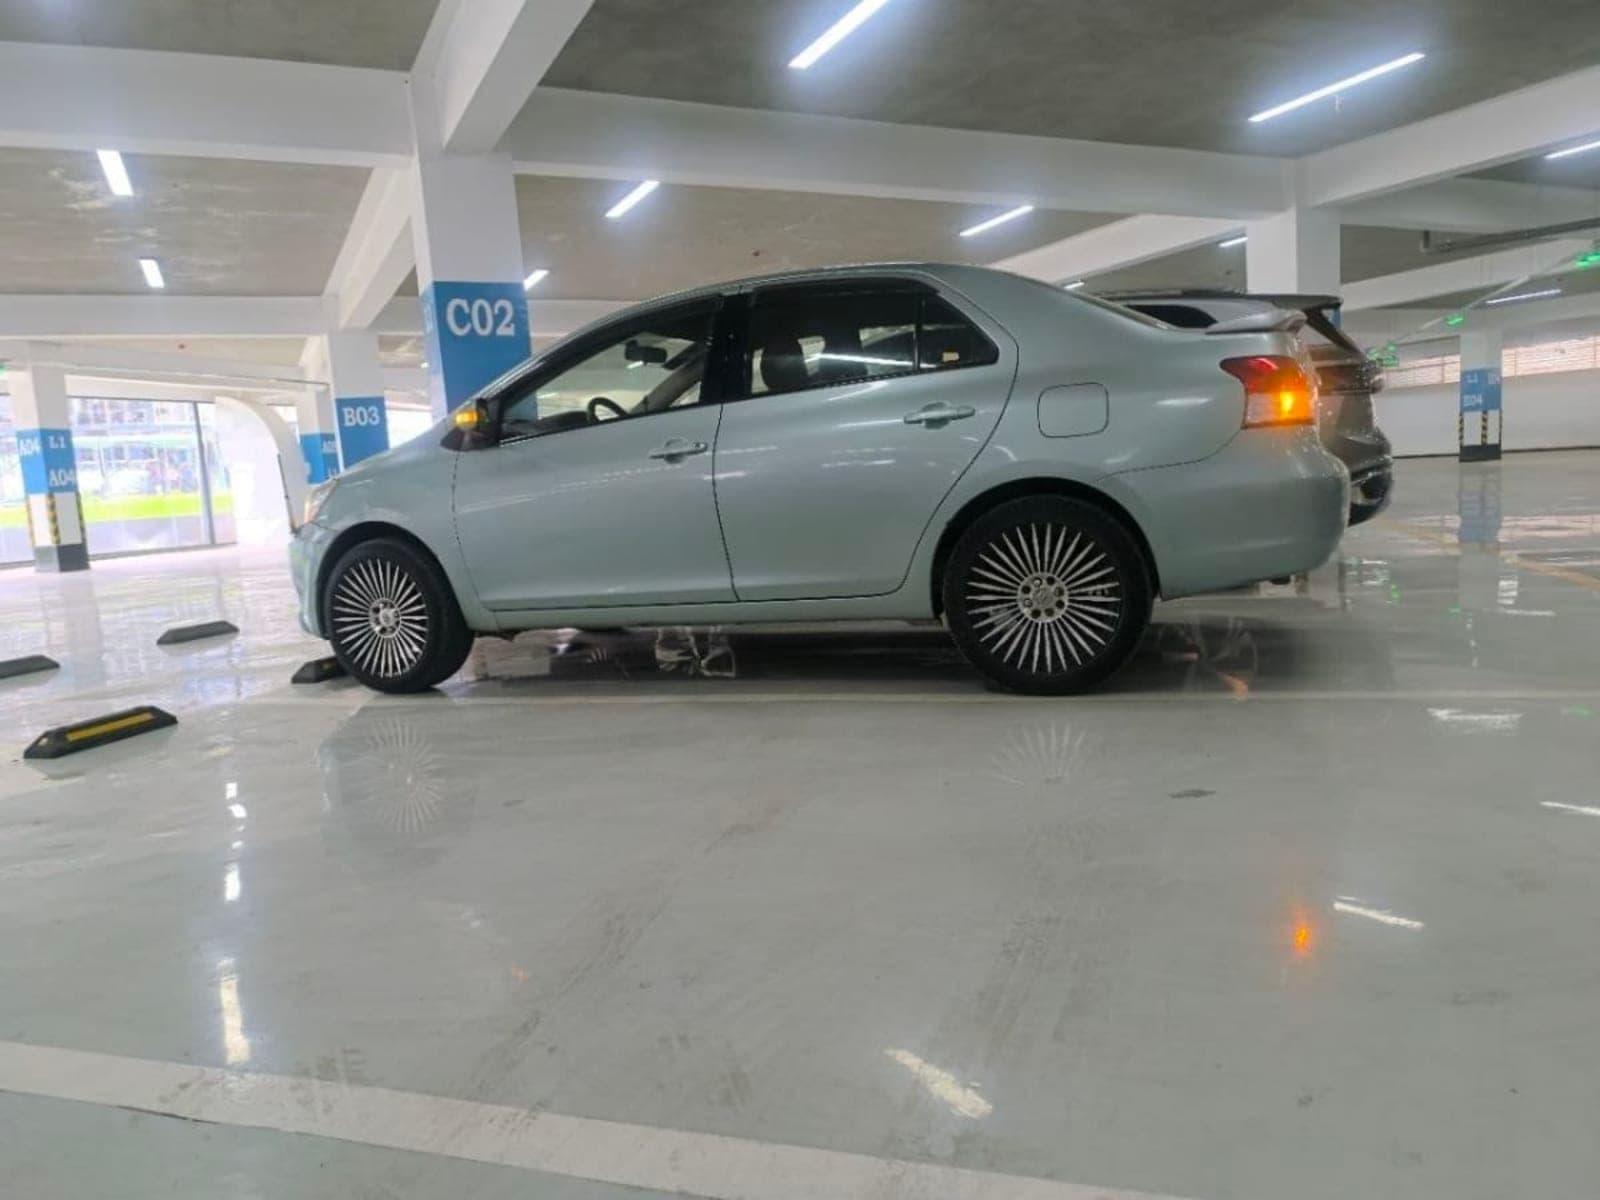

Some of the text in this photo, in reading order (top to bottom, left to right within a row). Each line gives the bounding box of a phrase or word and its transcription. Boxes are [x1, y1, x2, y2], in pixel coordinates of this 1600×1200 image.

[446, 298, 515, 336] C02
[344, 406, 380, 426] B03
[49, 436, 66, 448] L1
[49, 470, 76, 486] A04
